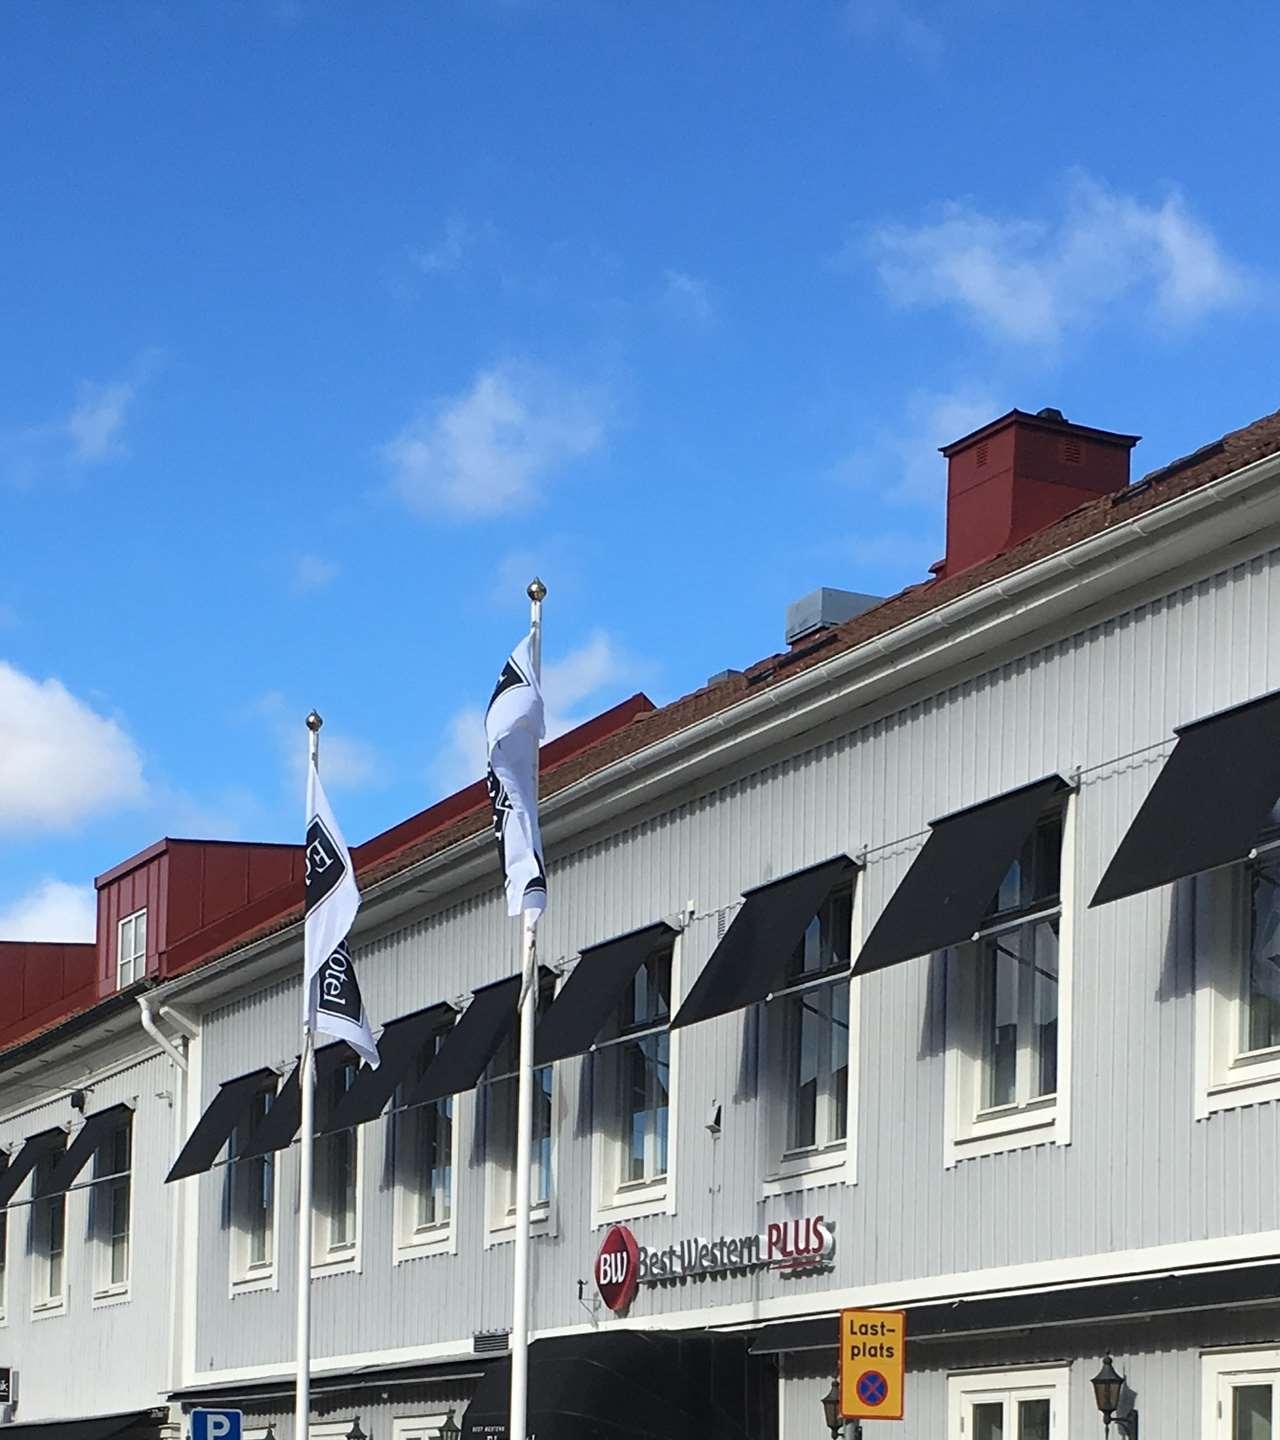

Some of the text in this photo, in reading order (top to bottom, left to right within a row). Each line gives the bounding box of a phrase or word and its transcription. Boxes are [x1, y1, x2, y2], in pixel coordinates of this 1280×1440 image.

[637, 1215, 825, 1278] Best Western PLUS
[600, 1251, 627, 1285] BW
[849, 1319, 896, 1337] Last-
[851, 1341, 895, 1361] plats
